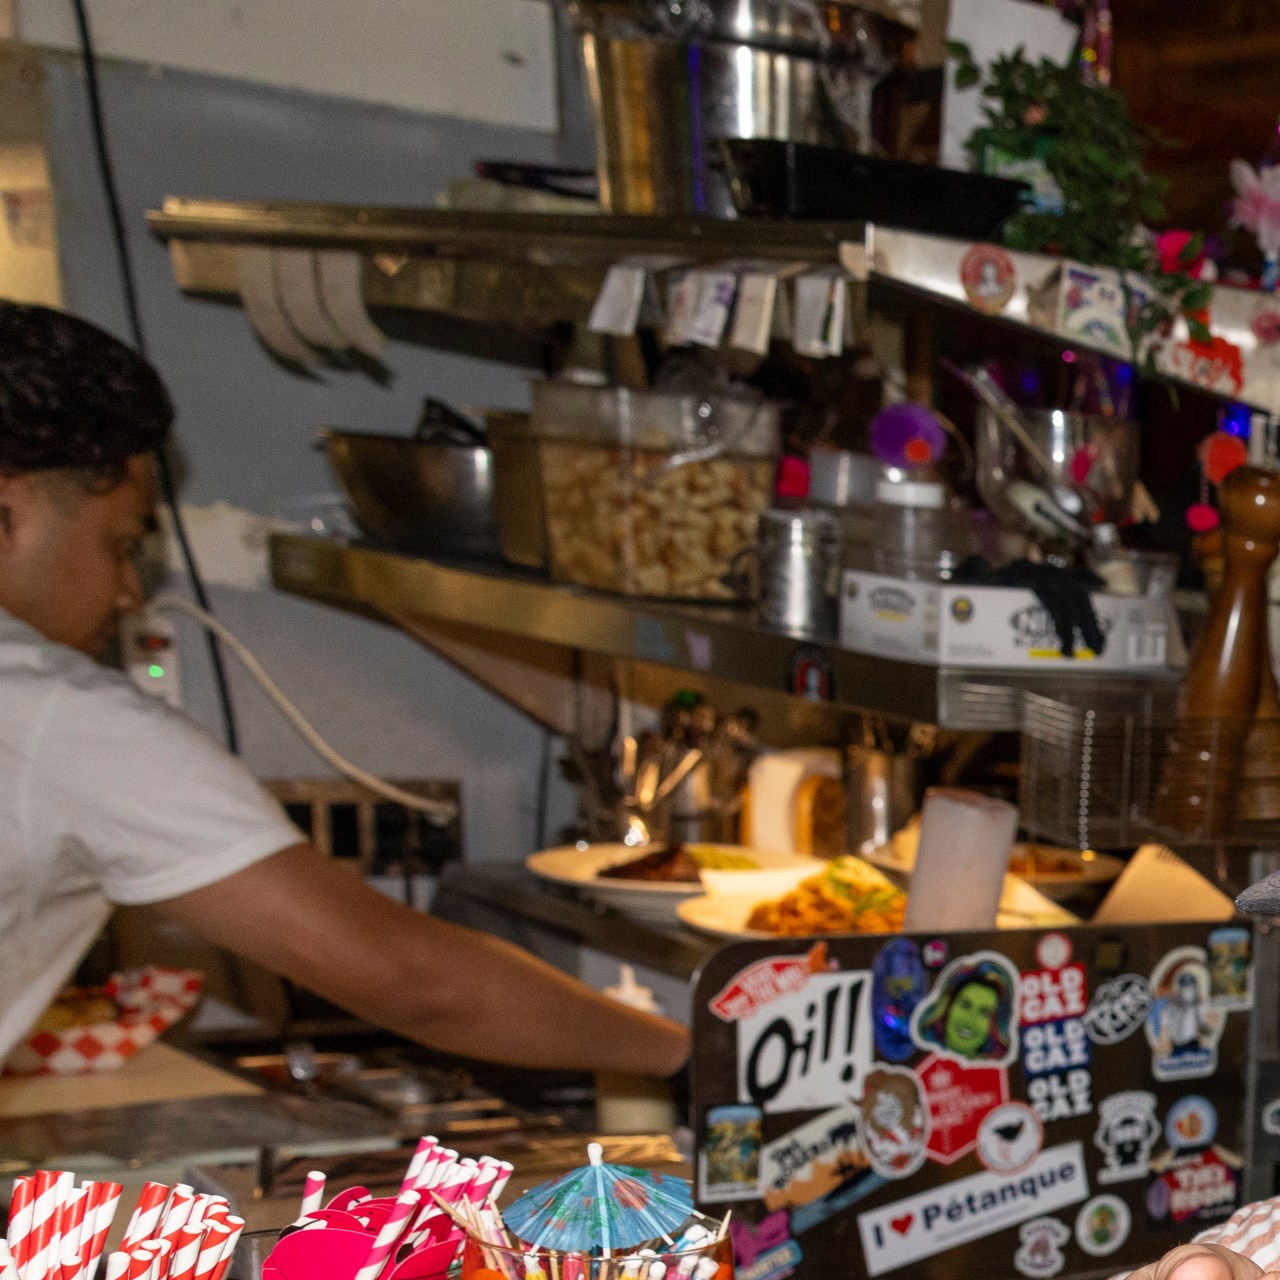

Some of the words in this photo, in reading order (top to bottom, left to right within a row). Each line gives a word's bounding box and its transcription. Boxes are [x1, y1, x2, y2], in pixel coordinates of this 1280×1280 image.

[1020, 966, 1085, 997] OLD
[1023, 1019, 1088, 1051] OLD
[1027, 1068, 1093, 1099] OLD
[921, 1160, 1076, 1231] Pétanque
